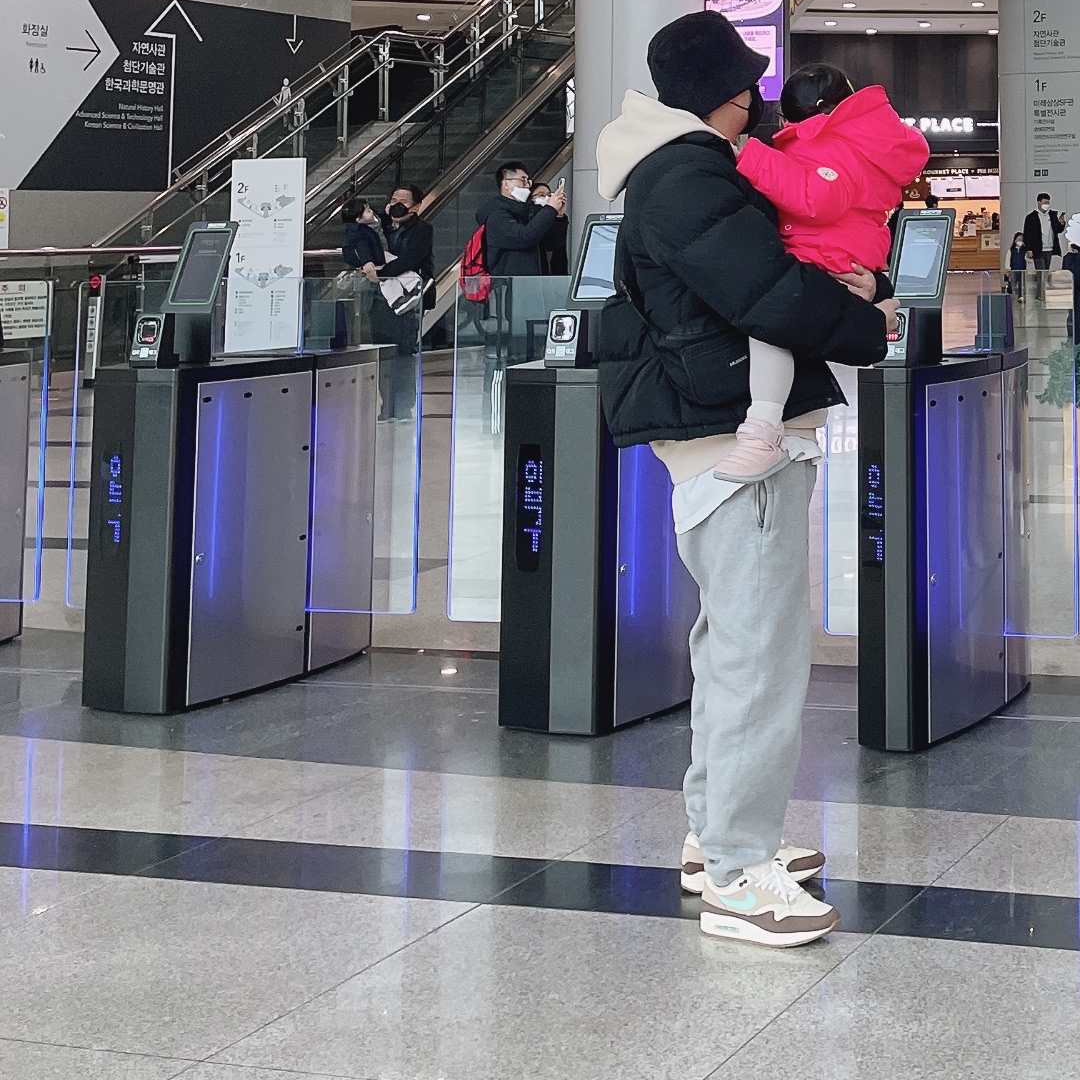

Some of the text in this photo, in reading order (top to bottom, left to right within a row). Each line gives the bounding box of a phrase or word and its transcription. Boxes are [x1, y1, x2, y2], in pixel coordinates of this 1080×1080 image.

[1033, 9, 1047, 23] 2F
[21, 22, 49, 38] 화장실
[132, 41, 166, 57] 자연사관
[123, 59, 166, 76] 첨단기술관
[104, 77, 165, 95] 한국과학문명관
[1034, 78, 1048, 92] 1F
[118, 103, 164, 114] Natural History Hall
[919, 117, 974, 133] PLACE
[237, 183, 249, 194] 2F
[235, 252, 246, 264] 1F
